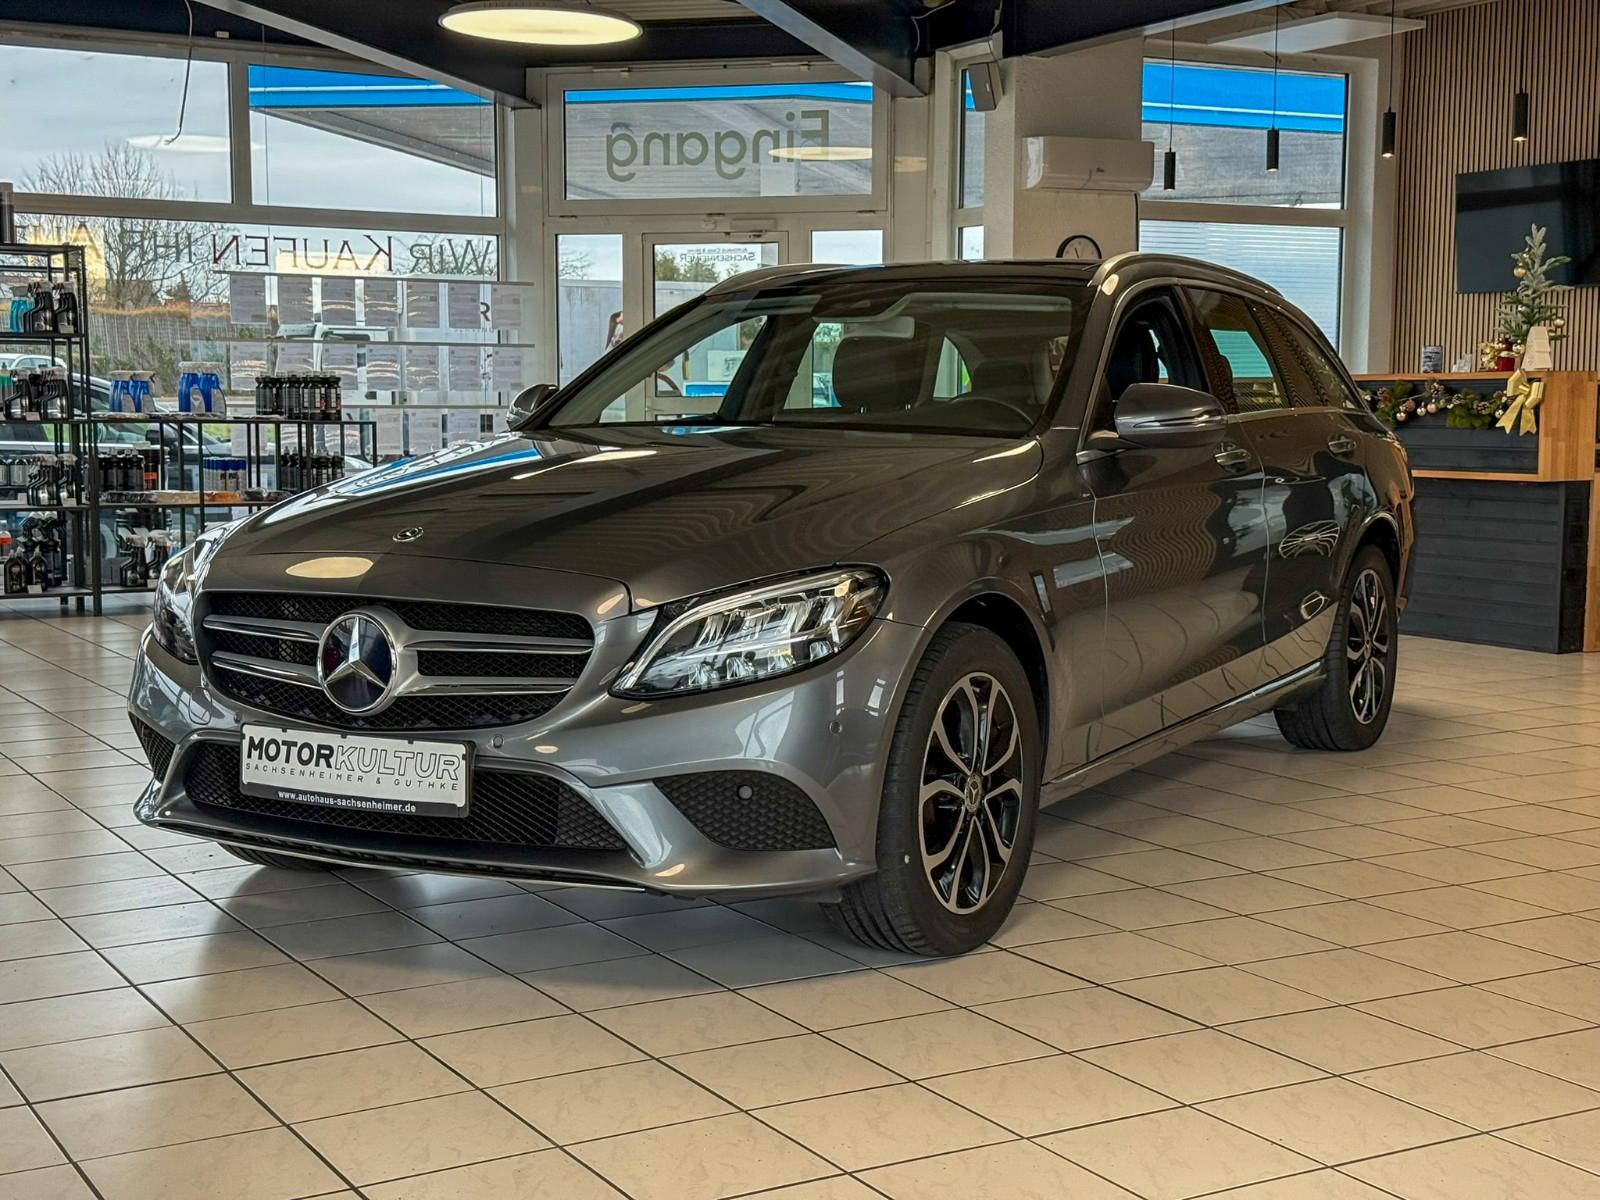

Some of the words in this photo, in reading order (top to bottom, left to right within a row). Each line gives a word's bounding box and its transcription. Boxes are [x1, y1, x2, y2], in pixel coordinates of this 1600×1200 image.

[247, 735, 461, 781] MOTORKULTUR
[245, 762, 364, 783] SACHSENHEIMER
[375, 777, 382, 785] &
[394, 778, 458, 791] GUTHKE
[277, 790, 416, 813] www.autohaus-sachsenheimer.de
